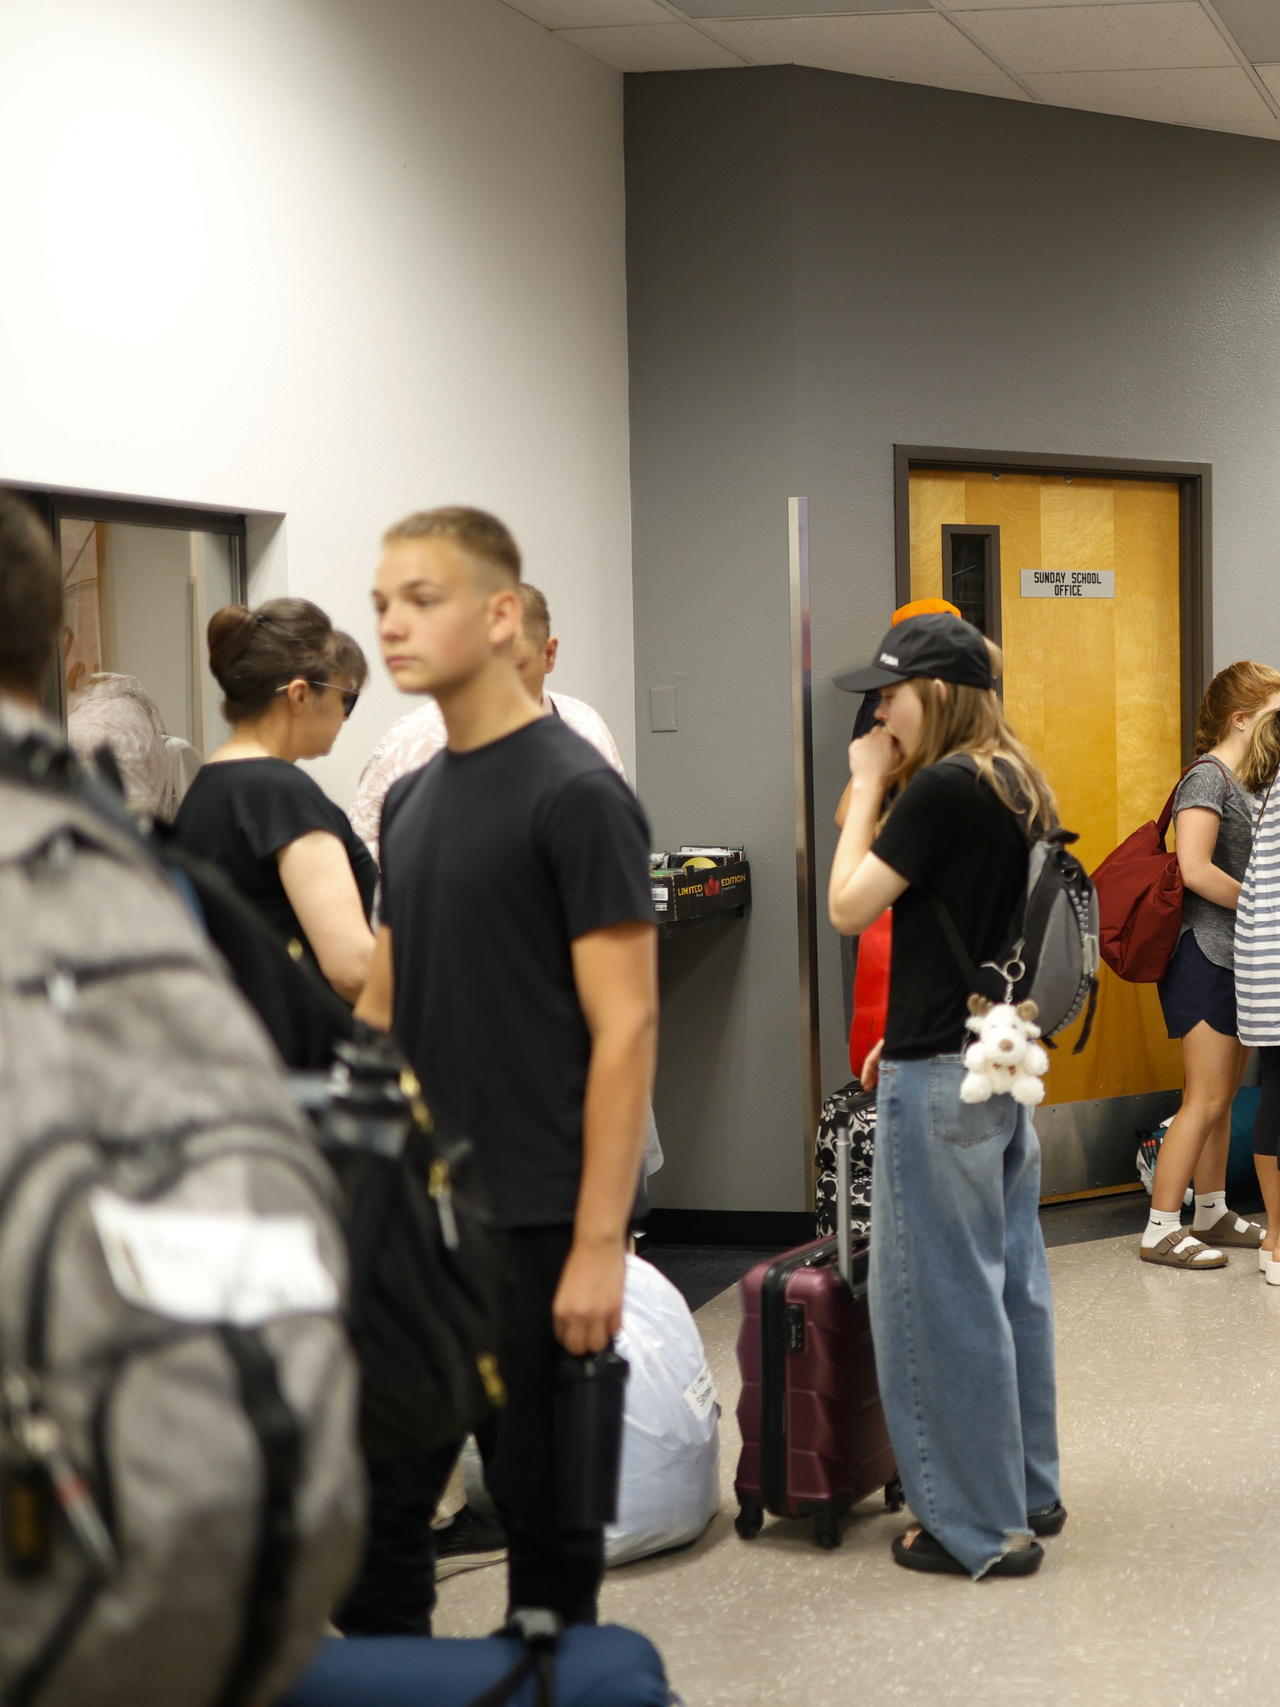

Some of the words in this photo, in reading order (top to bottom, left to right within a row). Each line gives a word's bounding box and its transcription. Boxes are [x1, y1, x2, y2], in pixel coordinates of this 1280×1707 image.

[1034, 572, 1066, 584] SUNDAY
[1071, 572, 1102, 584] SCHOOL
[1054, 584, 1082, 596] OFFICE
[677, 885, 703, 896] LIMITED
[721, 875, 746, 886] EDITION
